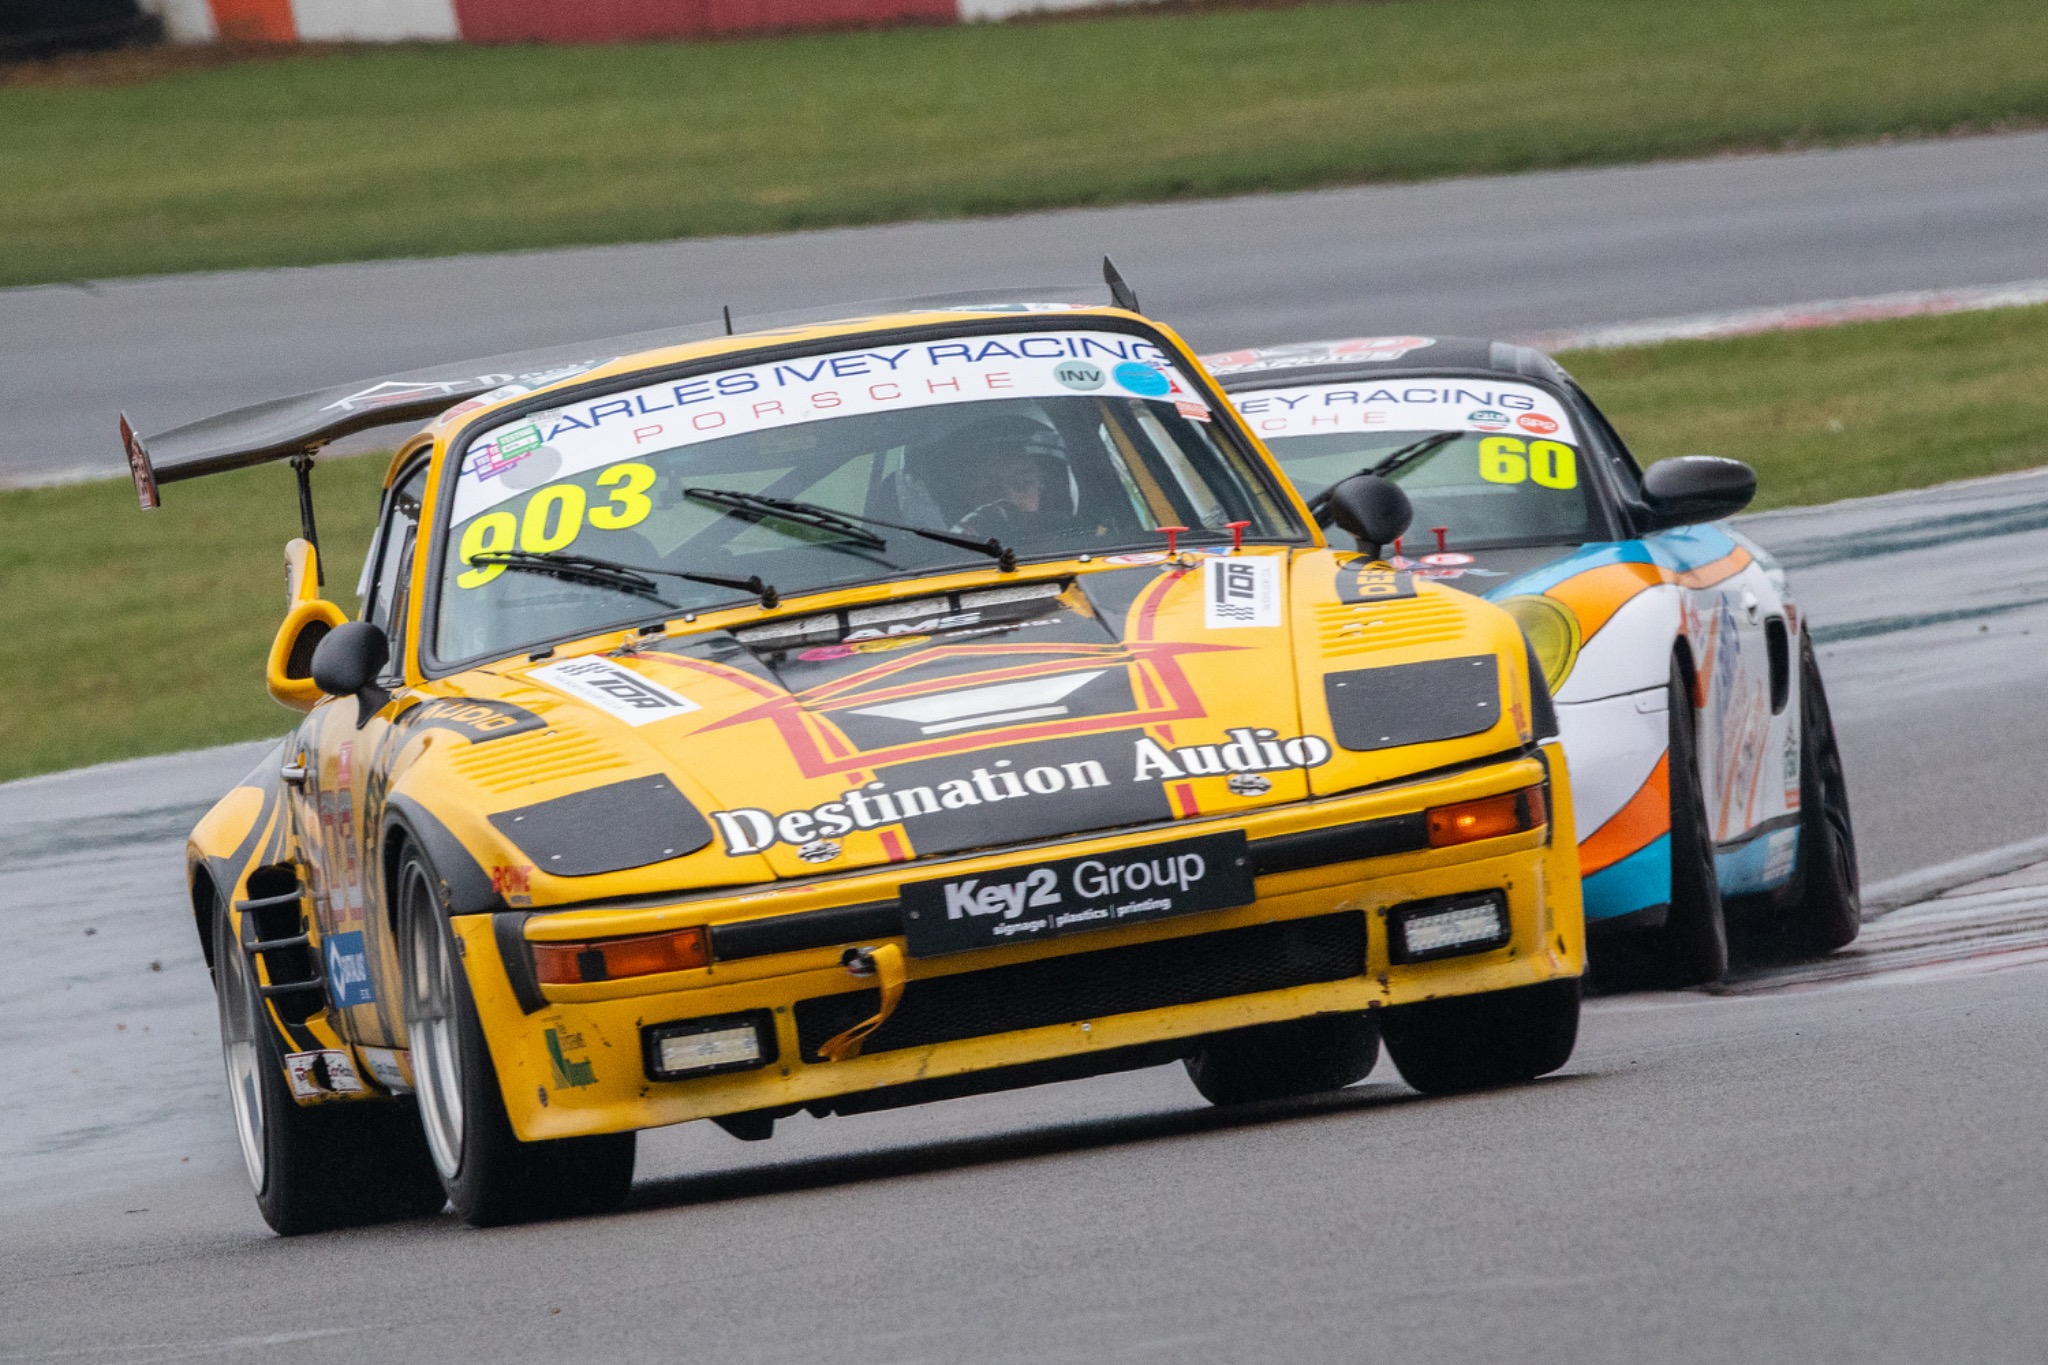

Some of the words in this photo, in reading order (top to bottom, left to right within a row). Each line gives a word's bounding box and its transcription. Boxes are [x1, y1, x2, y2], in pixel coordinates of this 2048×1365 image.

[1060, 369, 1101, 382] INV
[1233, 394, 1308, 415] EY
[1324, 388, 1534, 410] RACING
[461, 373, 759, 477] CARLES
[774, 349, 911, 386] IVEY
[633, 371, 1013, 444] PORSCHE
[1478, 436, 1578, 490] 60
[457, 462, 657, 590] 903
[842, 612, 982, 643] AMS
[714, 758, 1111, 854] Destination
[1133, 727, 1327, 783] Audio
[944, 868, 1062, 921] Key2
[1072, 853, 1206, 899] Group
[992, 918, 1048, 936] signage
[1055, 907, 1110, 928] plastics
[1116, 897, 1172, 917] printing
